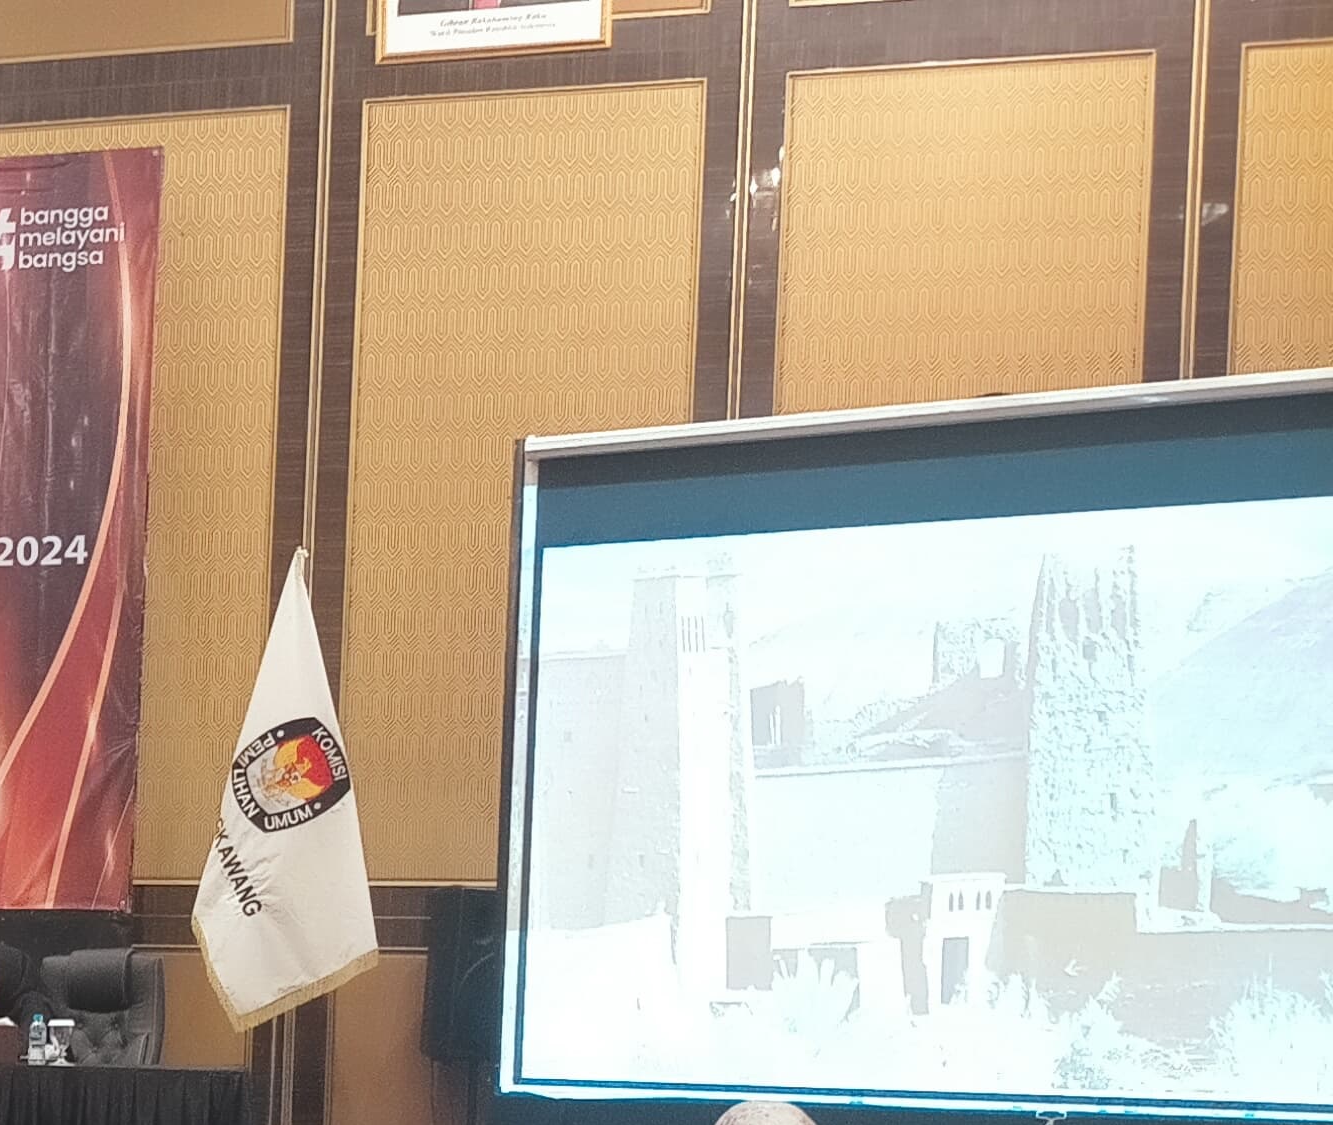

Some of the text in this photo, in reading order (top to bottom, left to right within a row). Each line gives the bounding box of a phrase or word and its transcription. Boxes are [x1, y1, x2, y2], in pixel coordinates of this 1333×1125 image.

[19, 205, 109, 230] bangga
[19, 222, 125, 248] melayani
[18, 247, 104, 272] bangsa
[311, 725, 348, 781] KOMISI
[264, 803, 314, 830] UMUM
